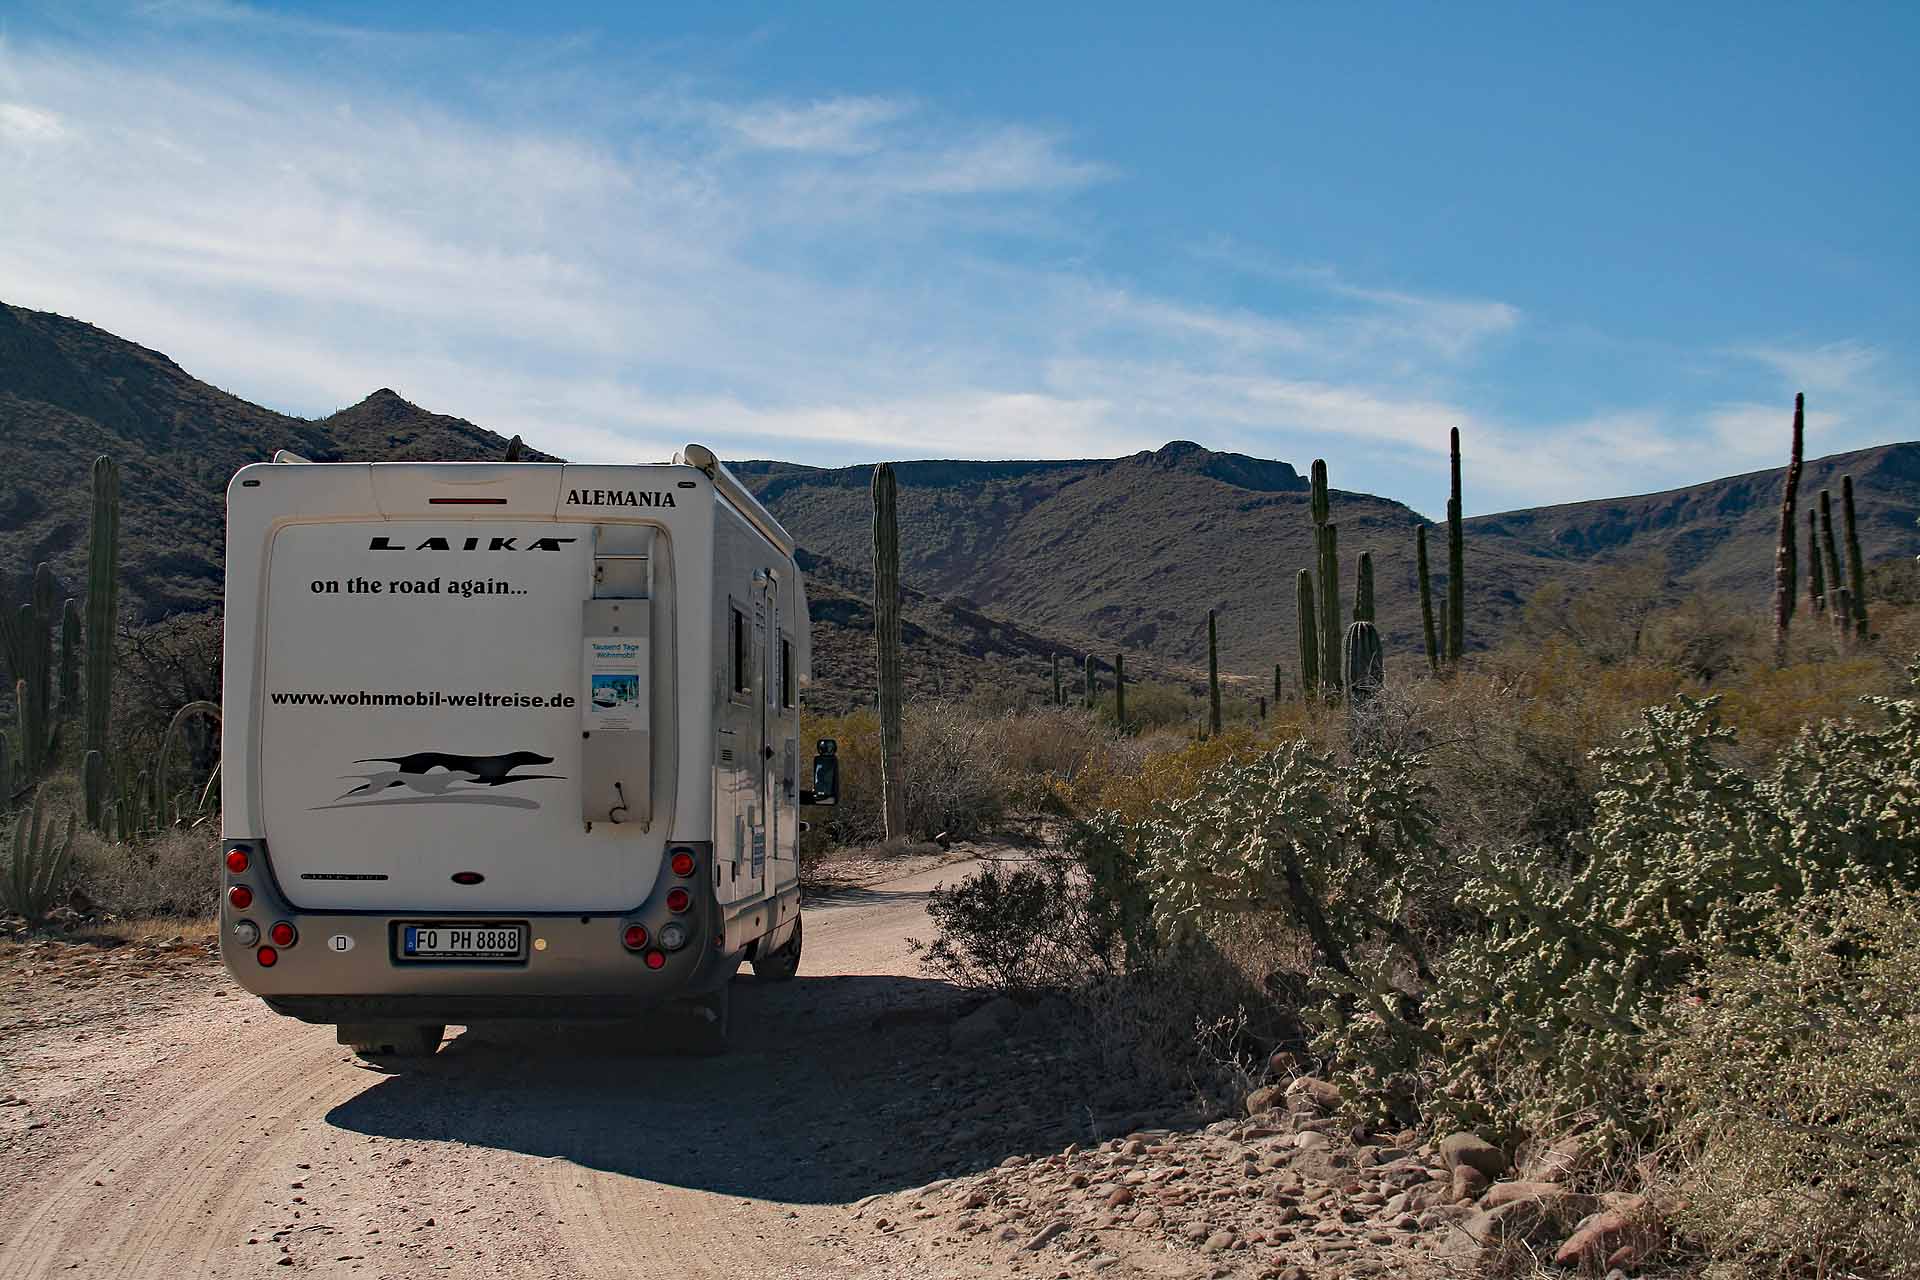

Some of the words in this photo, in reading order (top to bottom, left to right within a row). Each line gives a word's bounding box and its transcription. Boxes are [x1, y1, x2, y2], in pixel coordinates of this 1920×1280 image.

[566, 489, 677, 508] ALEMANIA
[369, 537, 577, 552] LAIKA
[310, 580, 340, 594] on
[347, 577, 382, 594] the
[389, 577, 440, 594] road
[447, 577, 528, 598] again...
[271, 691, 575, 708] www.wohnmobil-weltreise.de
[416, 931, 438, 949] FO
[450, 931, 472, 949] PH
[476, 931, 517, 949] 8888
